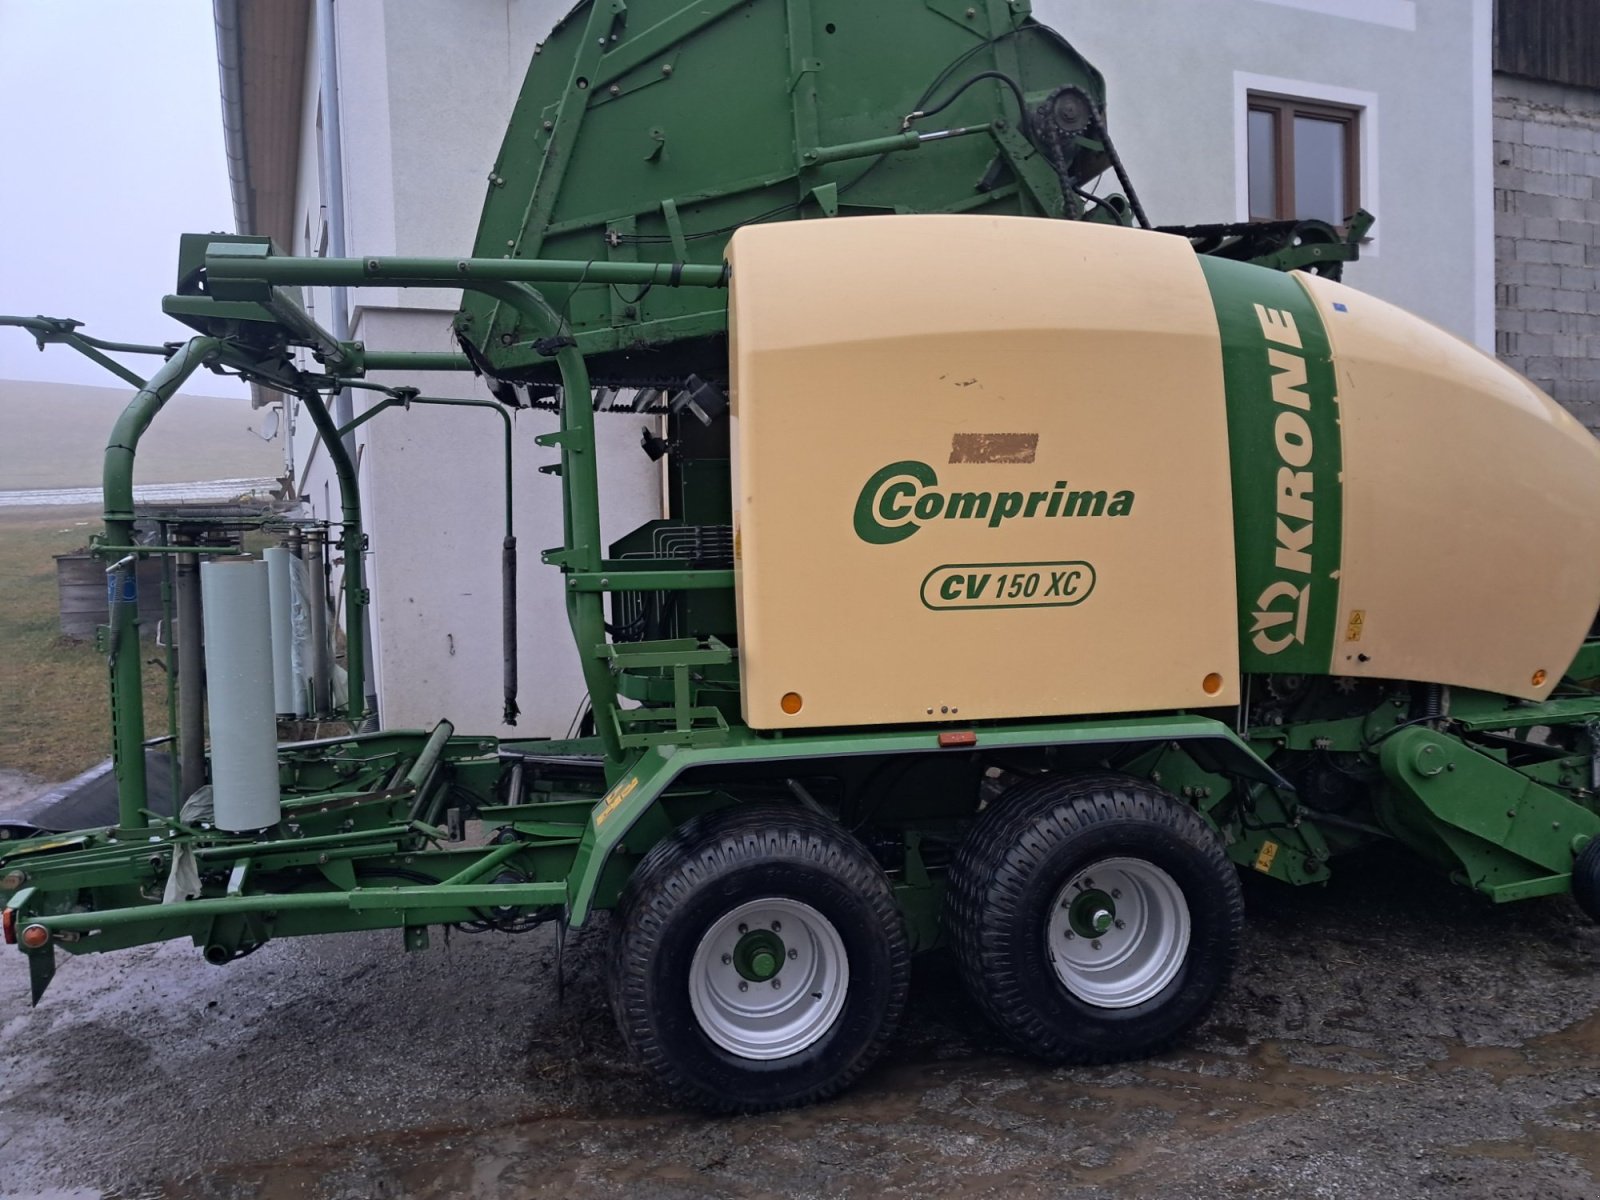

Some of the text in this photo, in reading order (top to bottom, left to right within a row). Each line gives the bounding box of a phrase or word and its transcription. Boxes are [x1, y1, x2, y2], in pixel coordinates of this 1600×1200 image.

[1254, 304, 1313, 573] KRONE
[939, 571, 1081, 600] CV 150 XC
